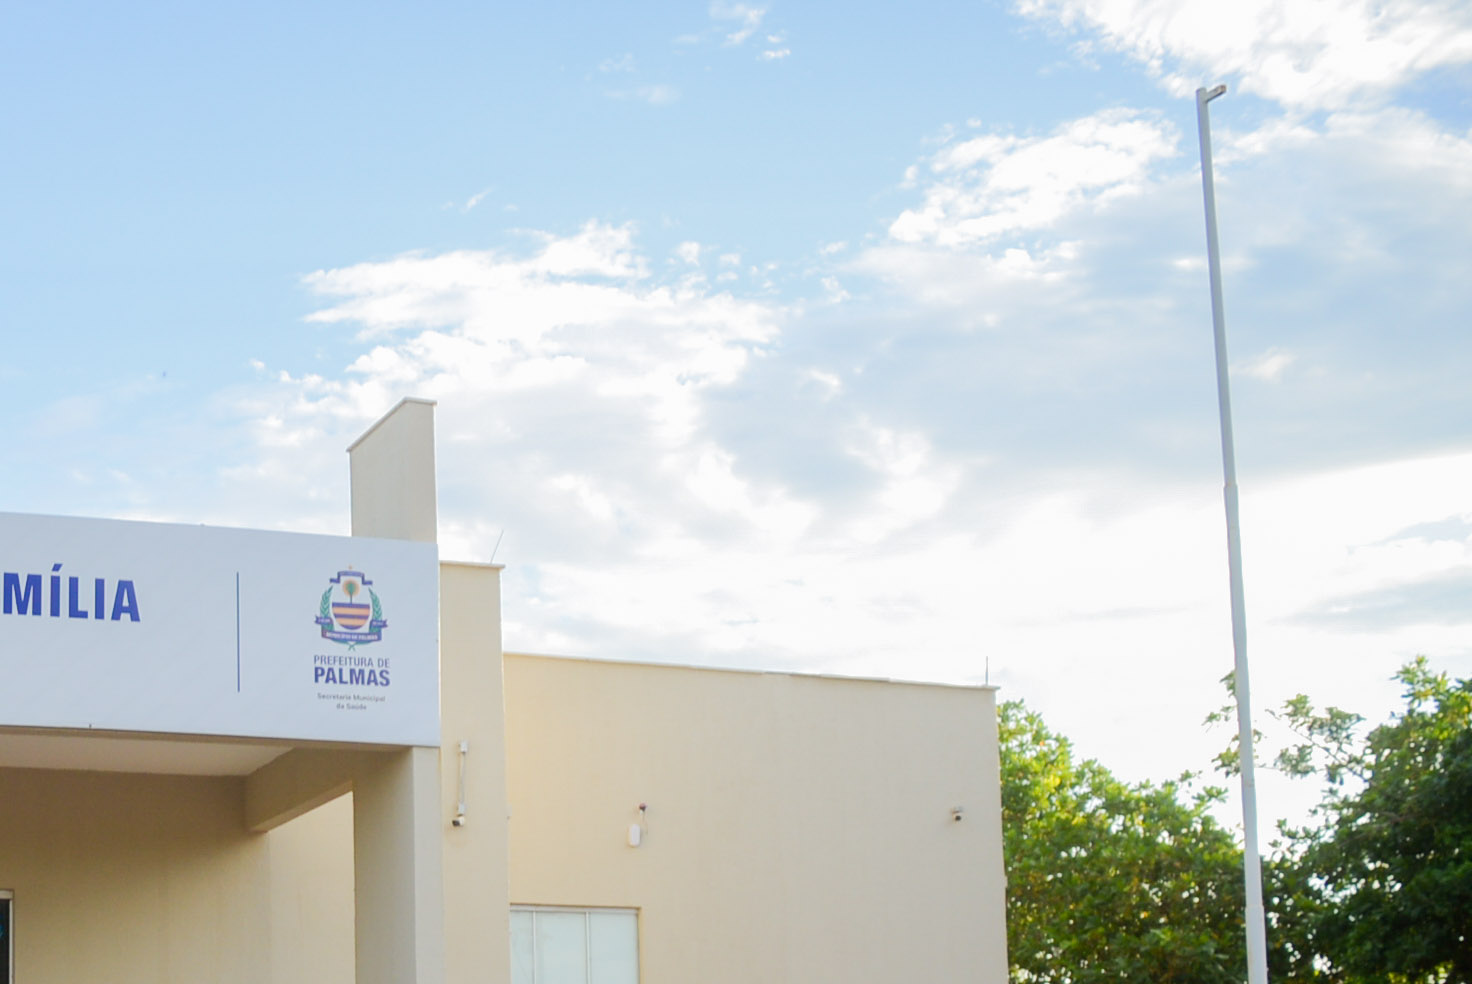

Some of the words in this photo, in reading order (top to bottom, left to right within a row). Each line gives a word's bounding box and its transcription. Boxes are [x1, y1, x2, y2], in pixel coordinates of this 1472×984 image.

[313, 655, 374, 668] PREFEITURA
[377, 657, 390, 668] DE
[314, 666, 391, 687] PALMAS
